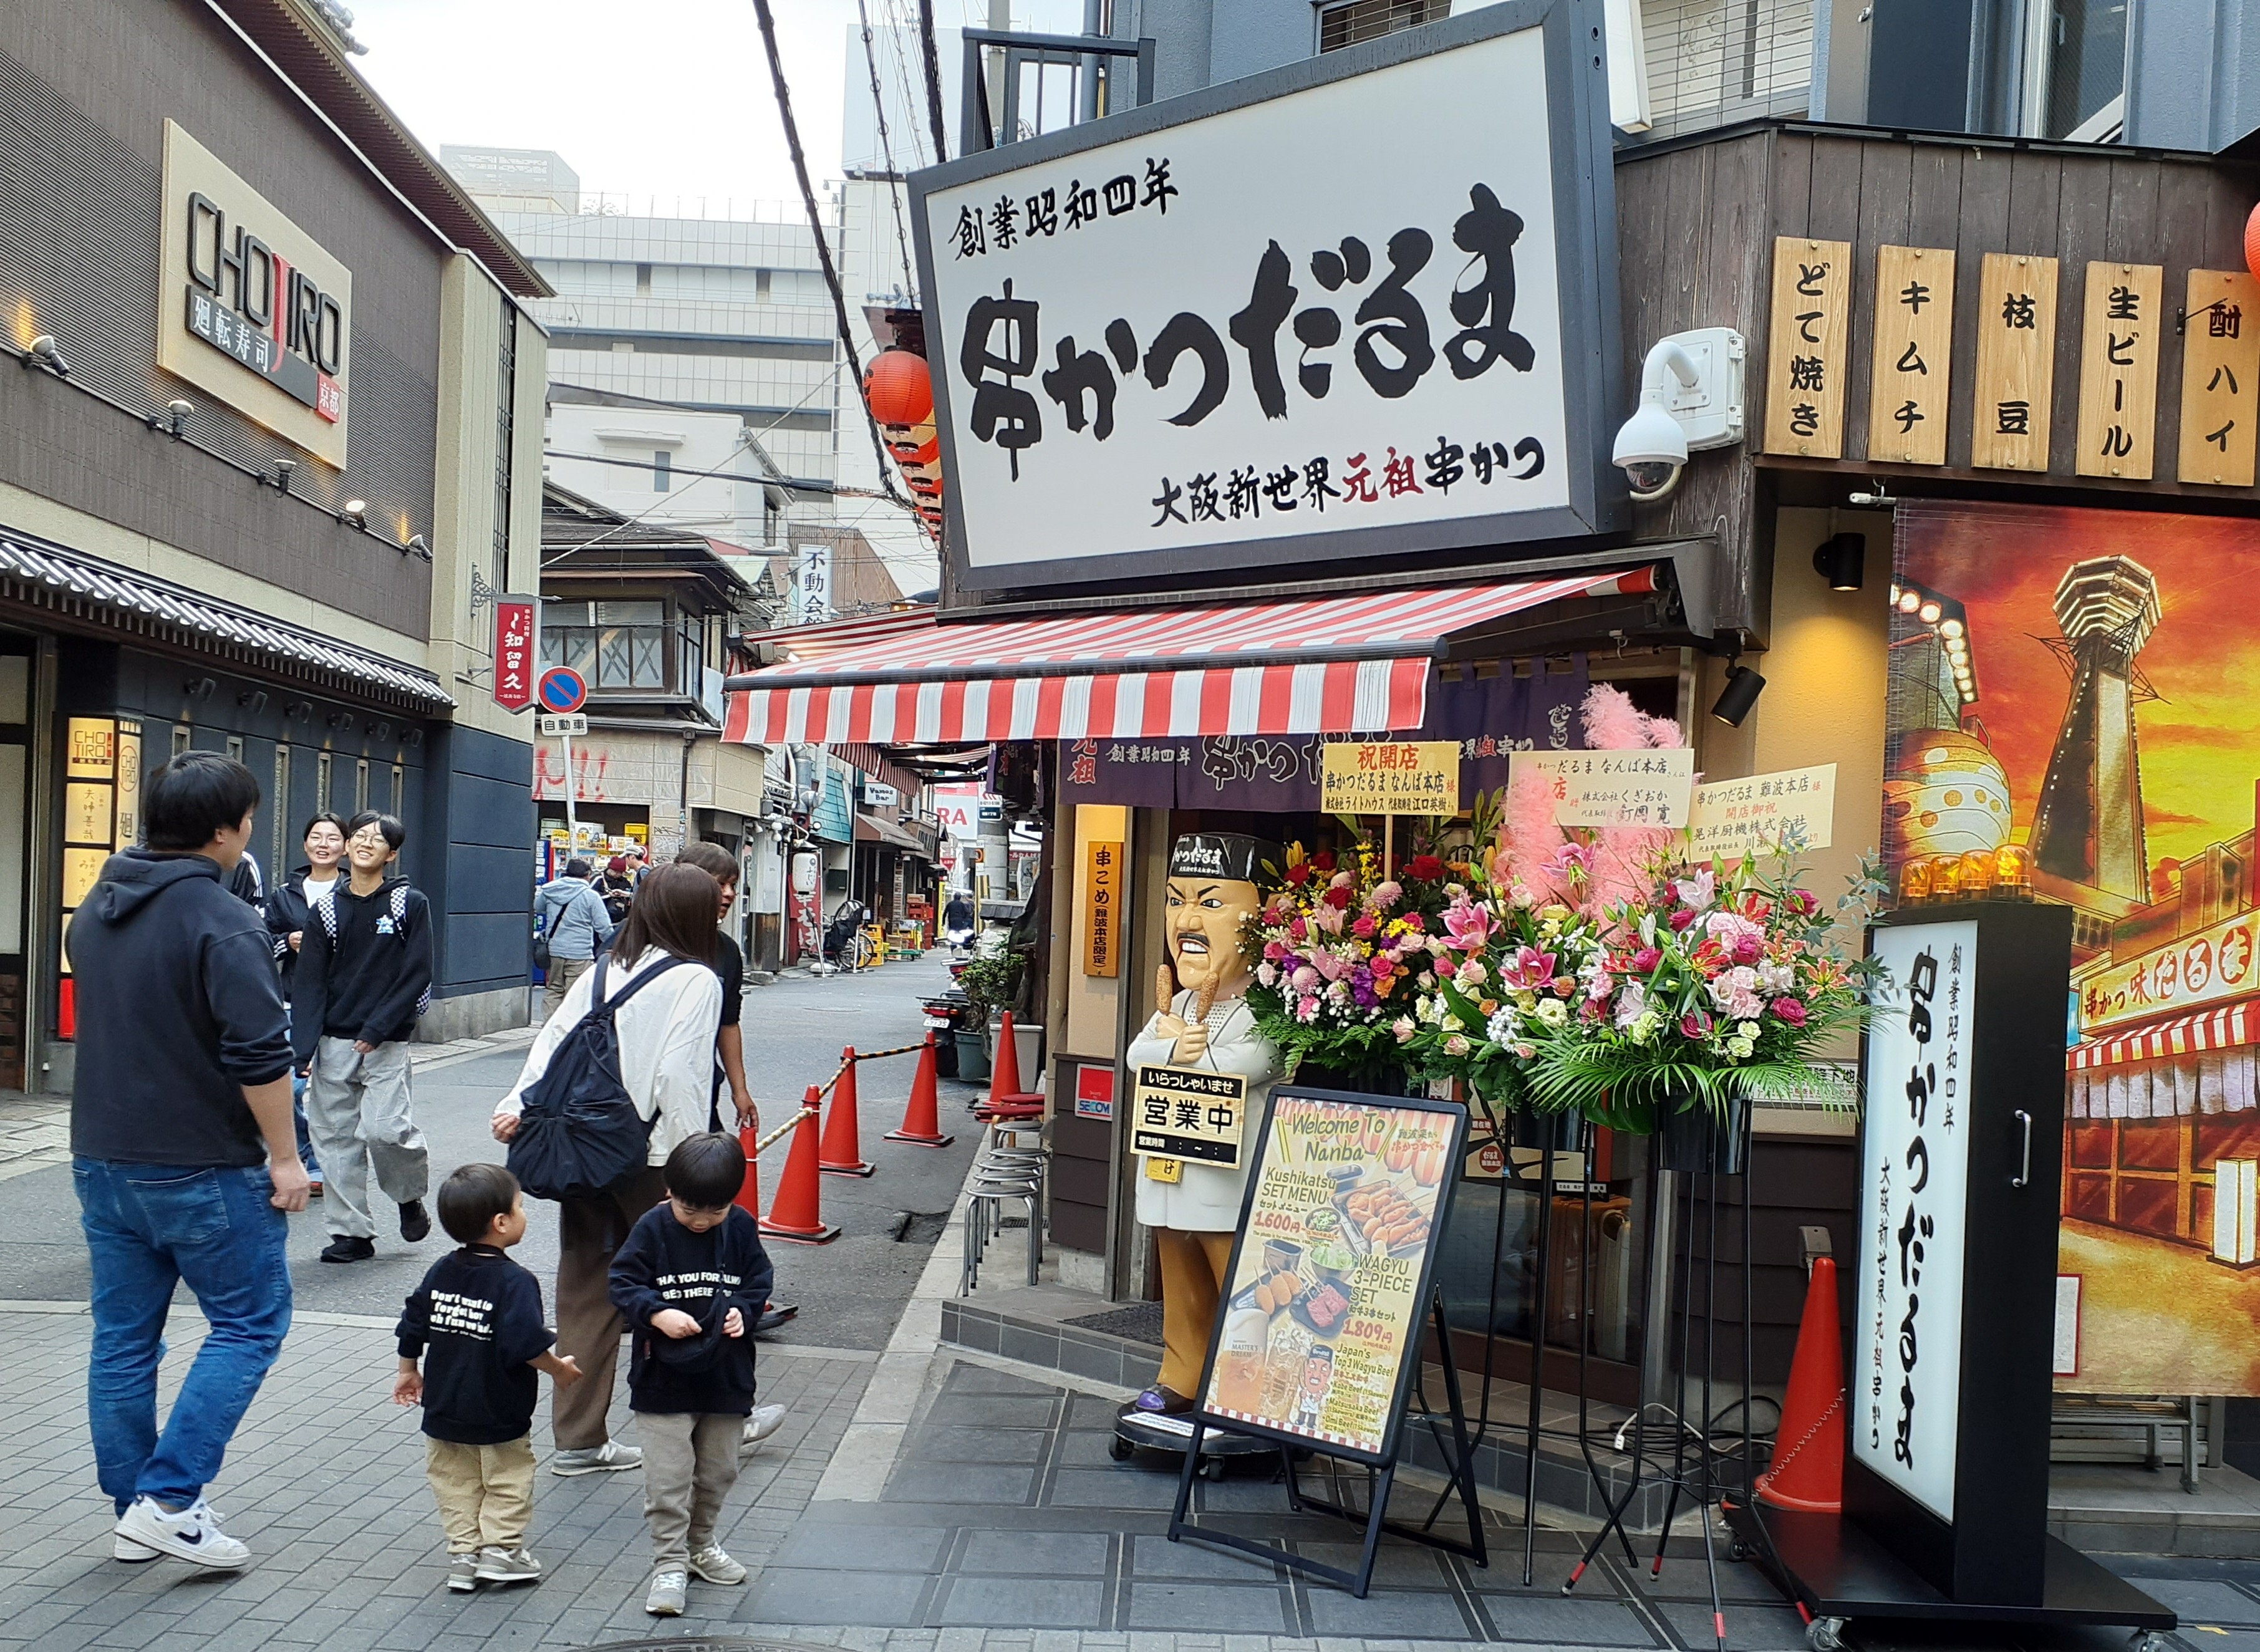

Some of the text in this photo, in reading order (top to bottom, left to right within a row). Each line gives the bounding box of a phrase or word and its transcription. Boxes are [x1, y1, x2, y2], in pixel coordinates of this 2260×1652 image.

[949, 157, 1179, 262] 創業昭和四年
[187, 192, 342, 377] CHOJIRO
[193, 294, 269, 374] 廻転寿司
[960, 182, 1535, 482] 串かつだるま
[1790, 261, 1830, 436] どて焼き
[1894, 280, 1931, 435] キムチ
[1996, 293, 2037, 435] 枝豆
[2100, 286, 2139, 457] 生ビール
[2205, 304, 2243, 453] 酎ハイ
[319, 382, 340, 416] 京都
[1150, 435, 1545, 528] 大阪新世界元祖串かつ
[544, 718, 585, 731] 自動車
[74, 730, 105, 744] CHO
[1105, 743, 1191, 766] 創業昭和四年
[1356, 743, 1420, 771] 祝開店
[1601, 757, 1668, 775] なんば本店
[869, 787, 894, 796] Vamos
[1326, 770, 1386, 793] 串かつだるま
[1391, 771, 1444, 794] なんば本店
[1697, 785, 1753, 808] 串かつだるま
[1759, 774, 1809, 798] 難波本店
[1725, 801, 1778, 819] 開店御祝
[1943, 942, 1962, 1136] 創業昭和四年
[1148, 1071, 1234, 1094] いらっしゃいませ
[1079, 1100, 1110, 1114] SECOM
[1144, 1094, 1233, 1134] 営業中
[1292, 1112, 1386, 1135] Welcome To
[1304, 1139, 1364, 1162] Nanba
[1265, 1166, 1336, 1190] Kushikatsu
[1262, 1182, 1328, 1205] SET MENU
[1895, 944, 1938, 1471] 串かつだるま
[1359, 1253, 1409, 1275] WAGYU
[677, 1272, 699, 1284] YOU
[700, 1272, 720, 1283] FOR
[1354, 1269, 1412, 1294] 3-PIECE
[430, 1289, 461, 1303] Don't
[1350, 1286, 1379, 1304] SET
[1337, 1343, 1371, 1359] Japan's
[1334, 1355, 1394, 1377] Top 3 Wagyu Beef
